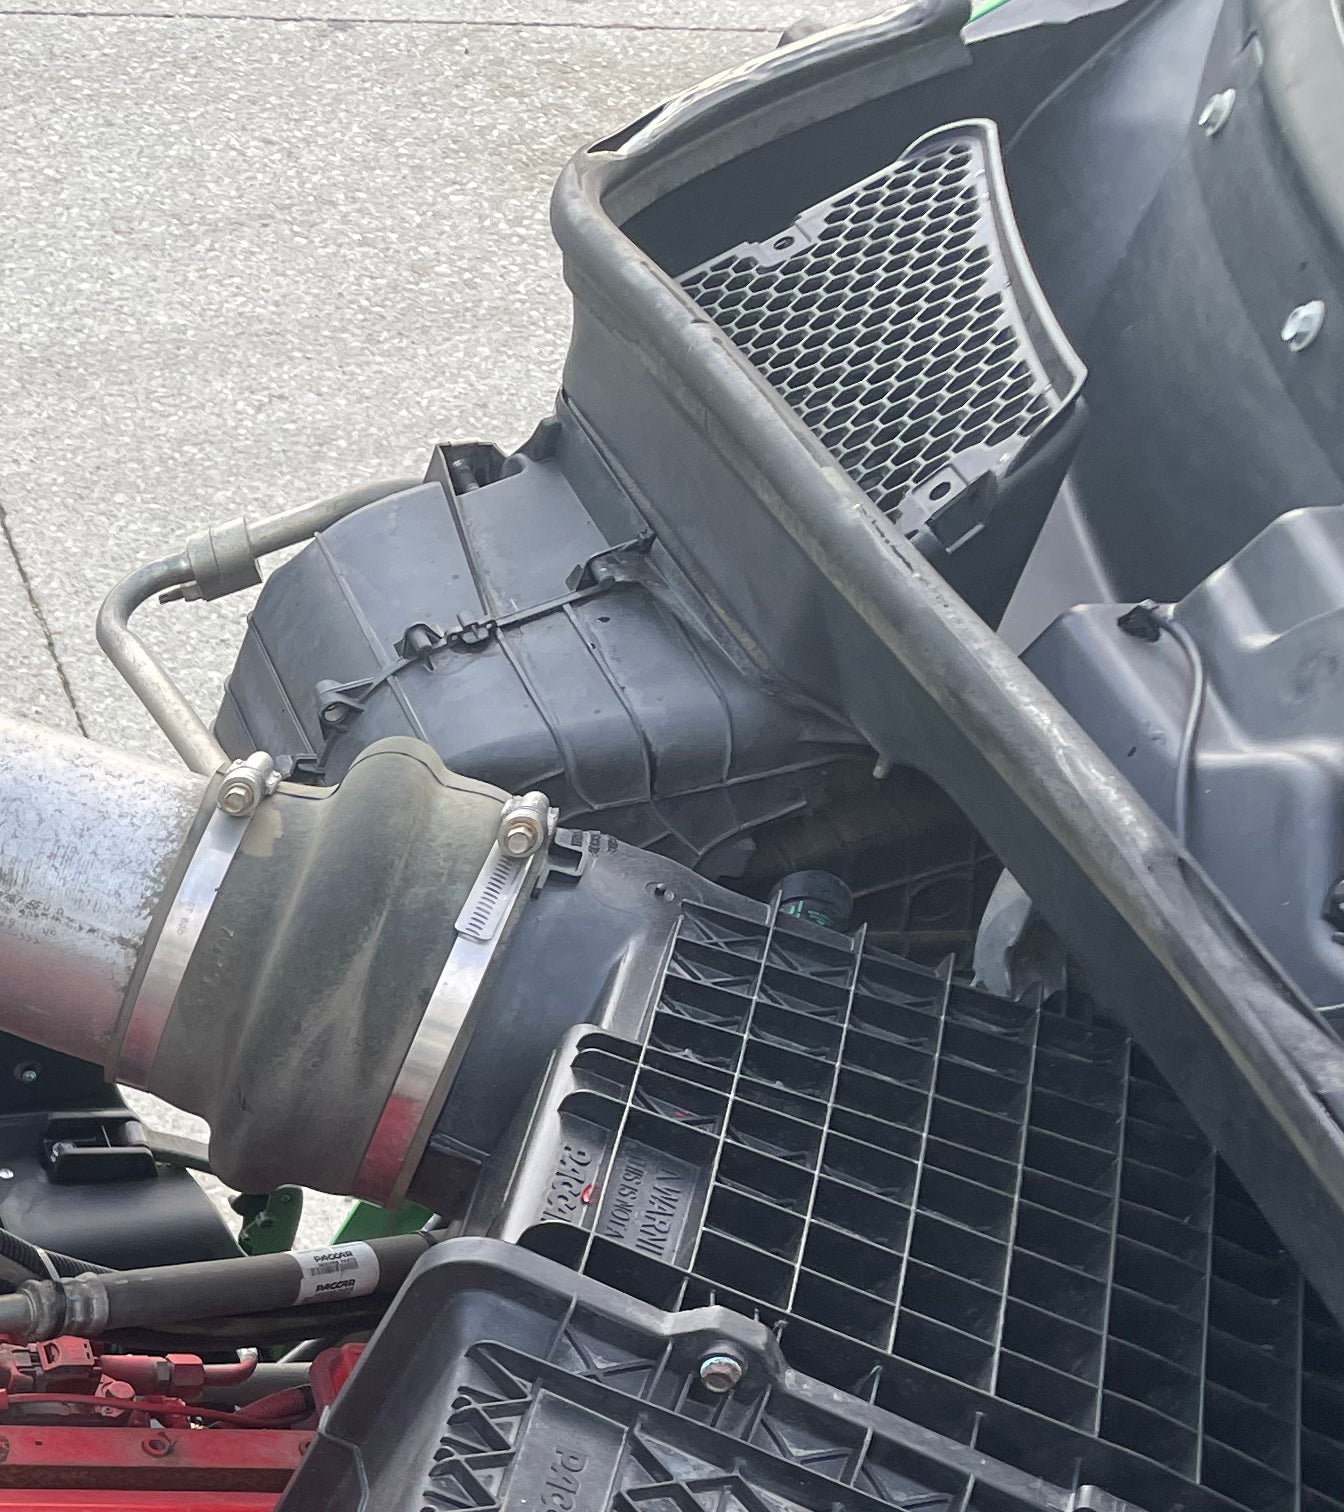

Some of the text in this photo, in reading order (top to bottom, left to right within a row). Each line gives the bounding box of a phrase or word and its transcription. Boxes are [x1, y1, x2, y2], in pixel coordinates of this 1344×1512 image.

[540, 1145, 593, 1222] PACCA
[313, 1250, 354, 1263] PACCAR
[315, 1278, 356, 1292] PACCAR
